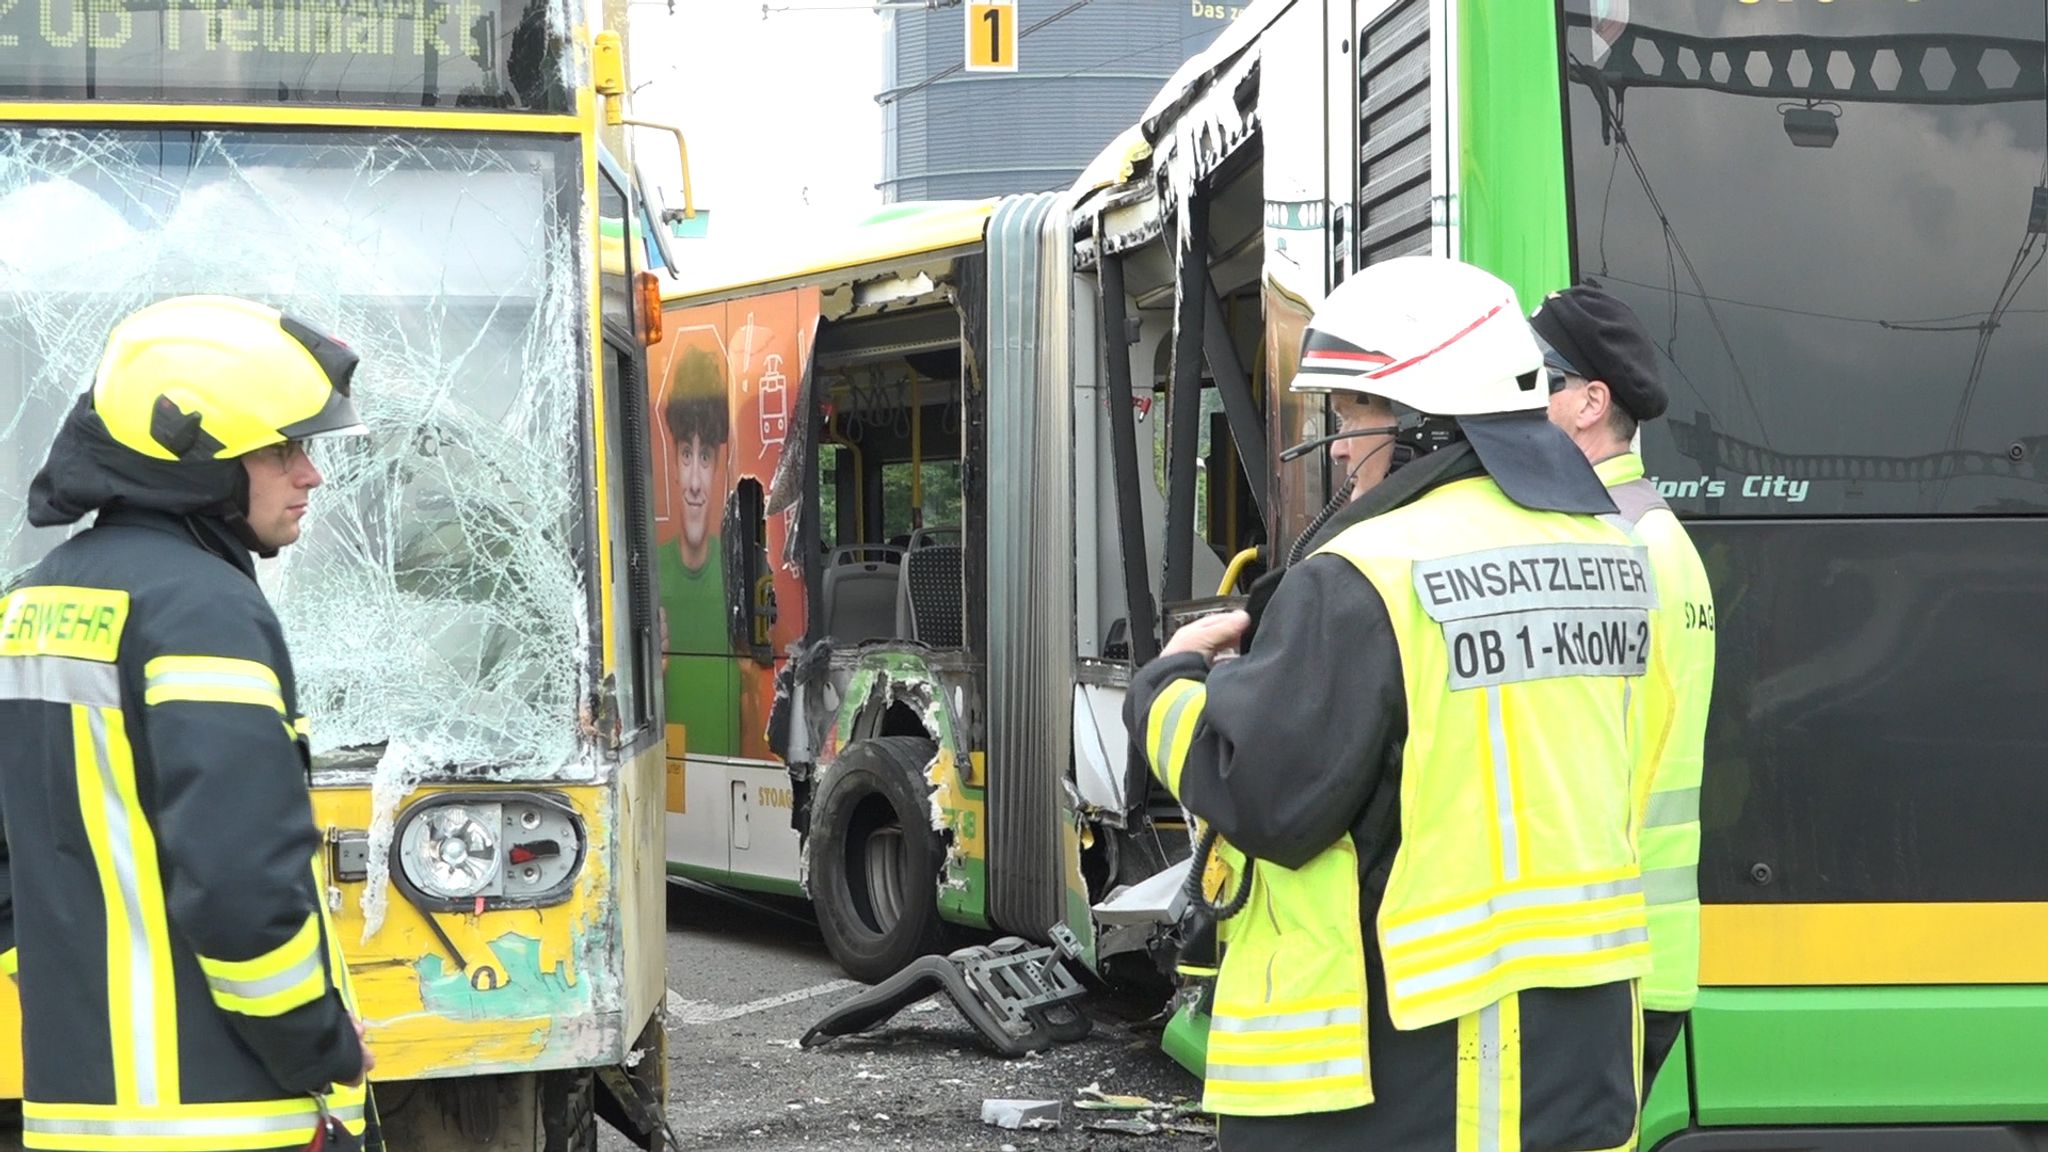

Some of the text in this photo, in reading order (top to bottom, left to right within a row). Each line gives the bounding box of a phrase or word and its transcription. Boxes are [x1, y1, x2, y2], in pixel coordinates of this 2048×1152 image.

[1191, 0, 1225, 19] Das
[983, 8, 999, 63] 1
[1742, 475, 1809, 502] City
[1423, 556, 1648, 606] EINSATZLEITER
[0, 602, 115, 644] ERWEHR
[1453, 629, 1506, 679] OB
